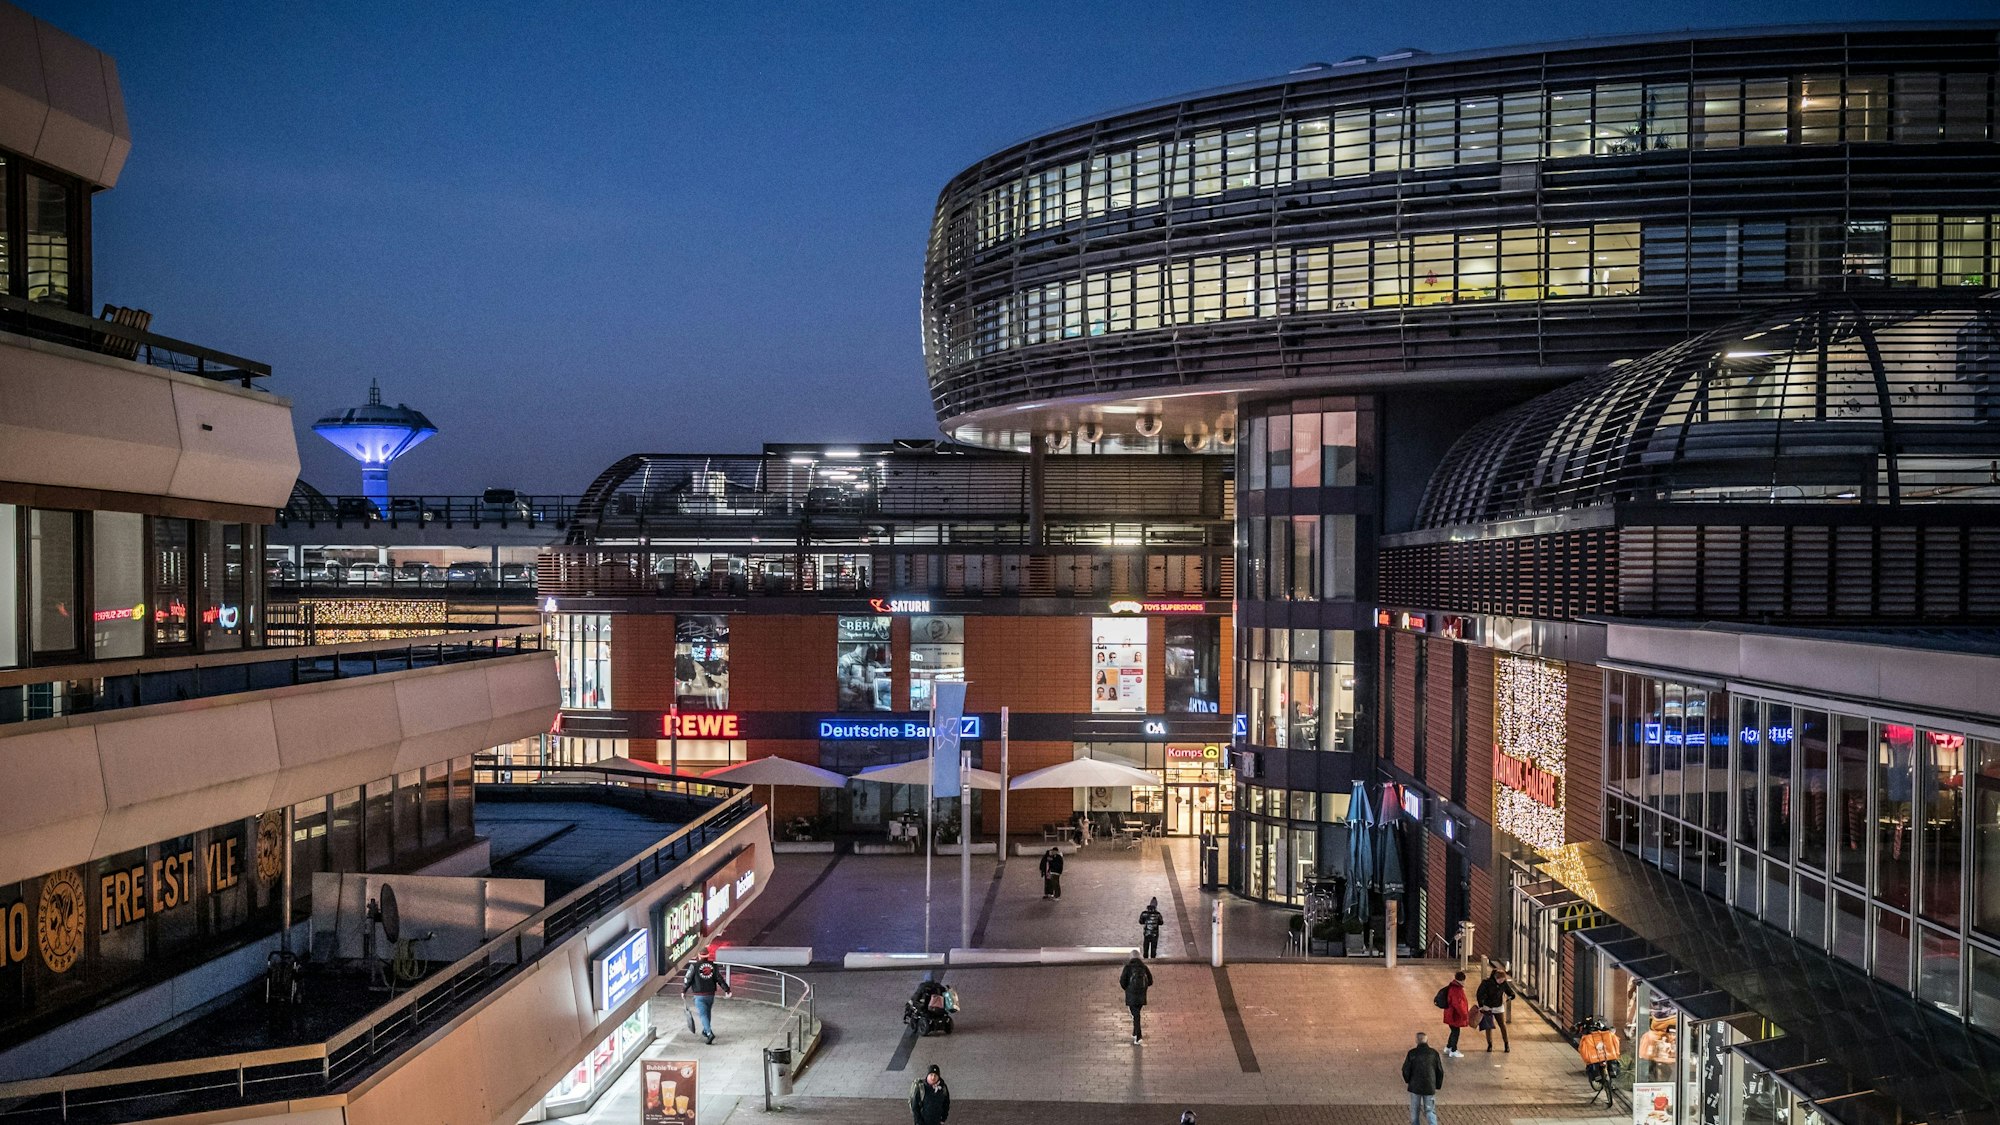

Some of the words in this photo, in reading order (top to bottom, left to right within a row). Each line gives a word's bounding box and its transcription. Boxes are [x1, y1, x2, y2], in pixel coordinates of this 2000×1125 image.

[890, 600, 930, 612] SATURN
[663, 713, 739, 737] REWE
[820, 723, 899, 738] Deutsche
[904, 723, 936, 738] Ban
[1168, 747, 1203, 758] Kamps
